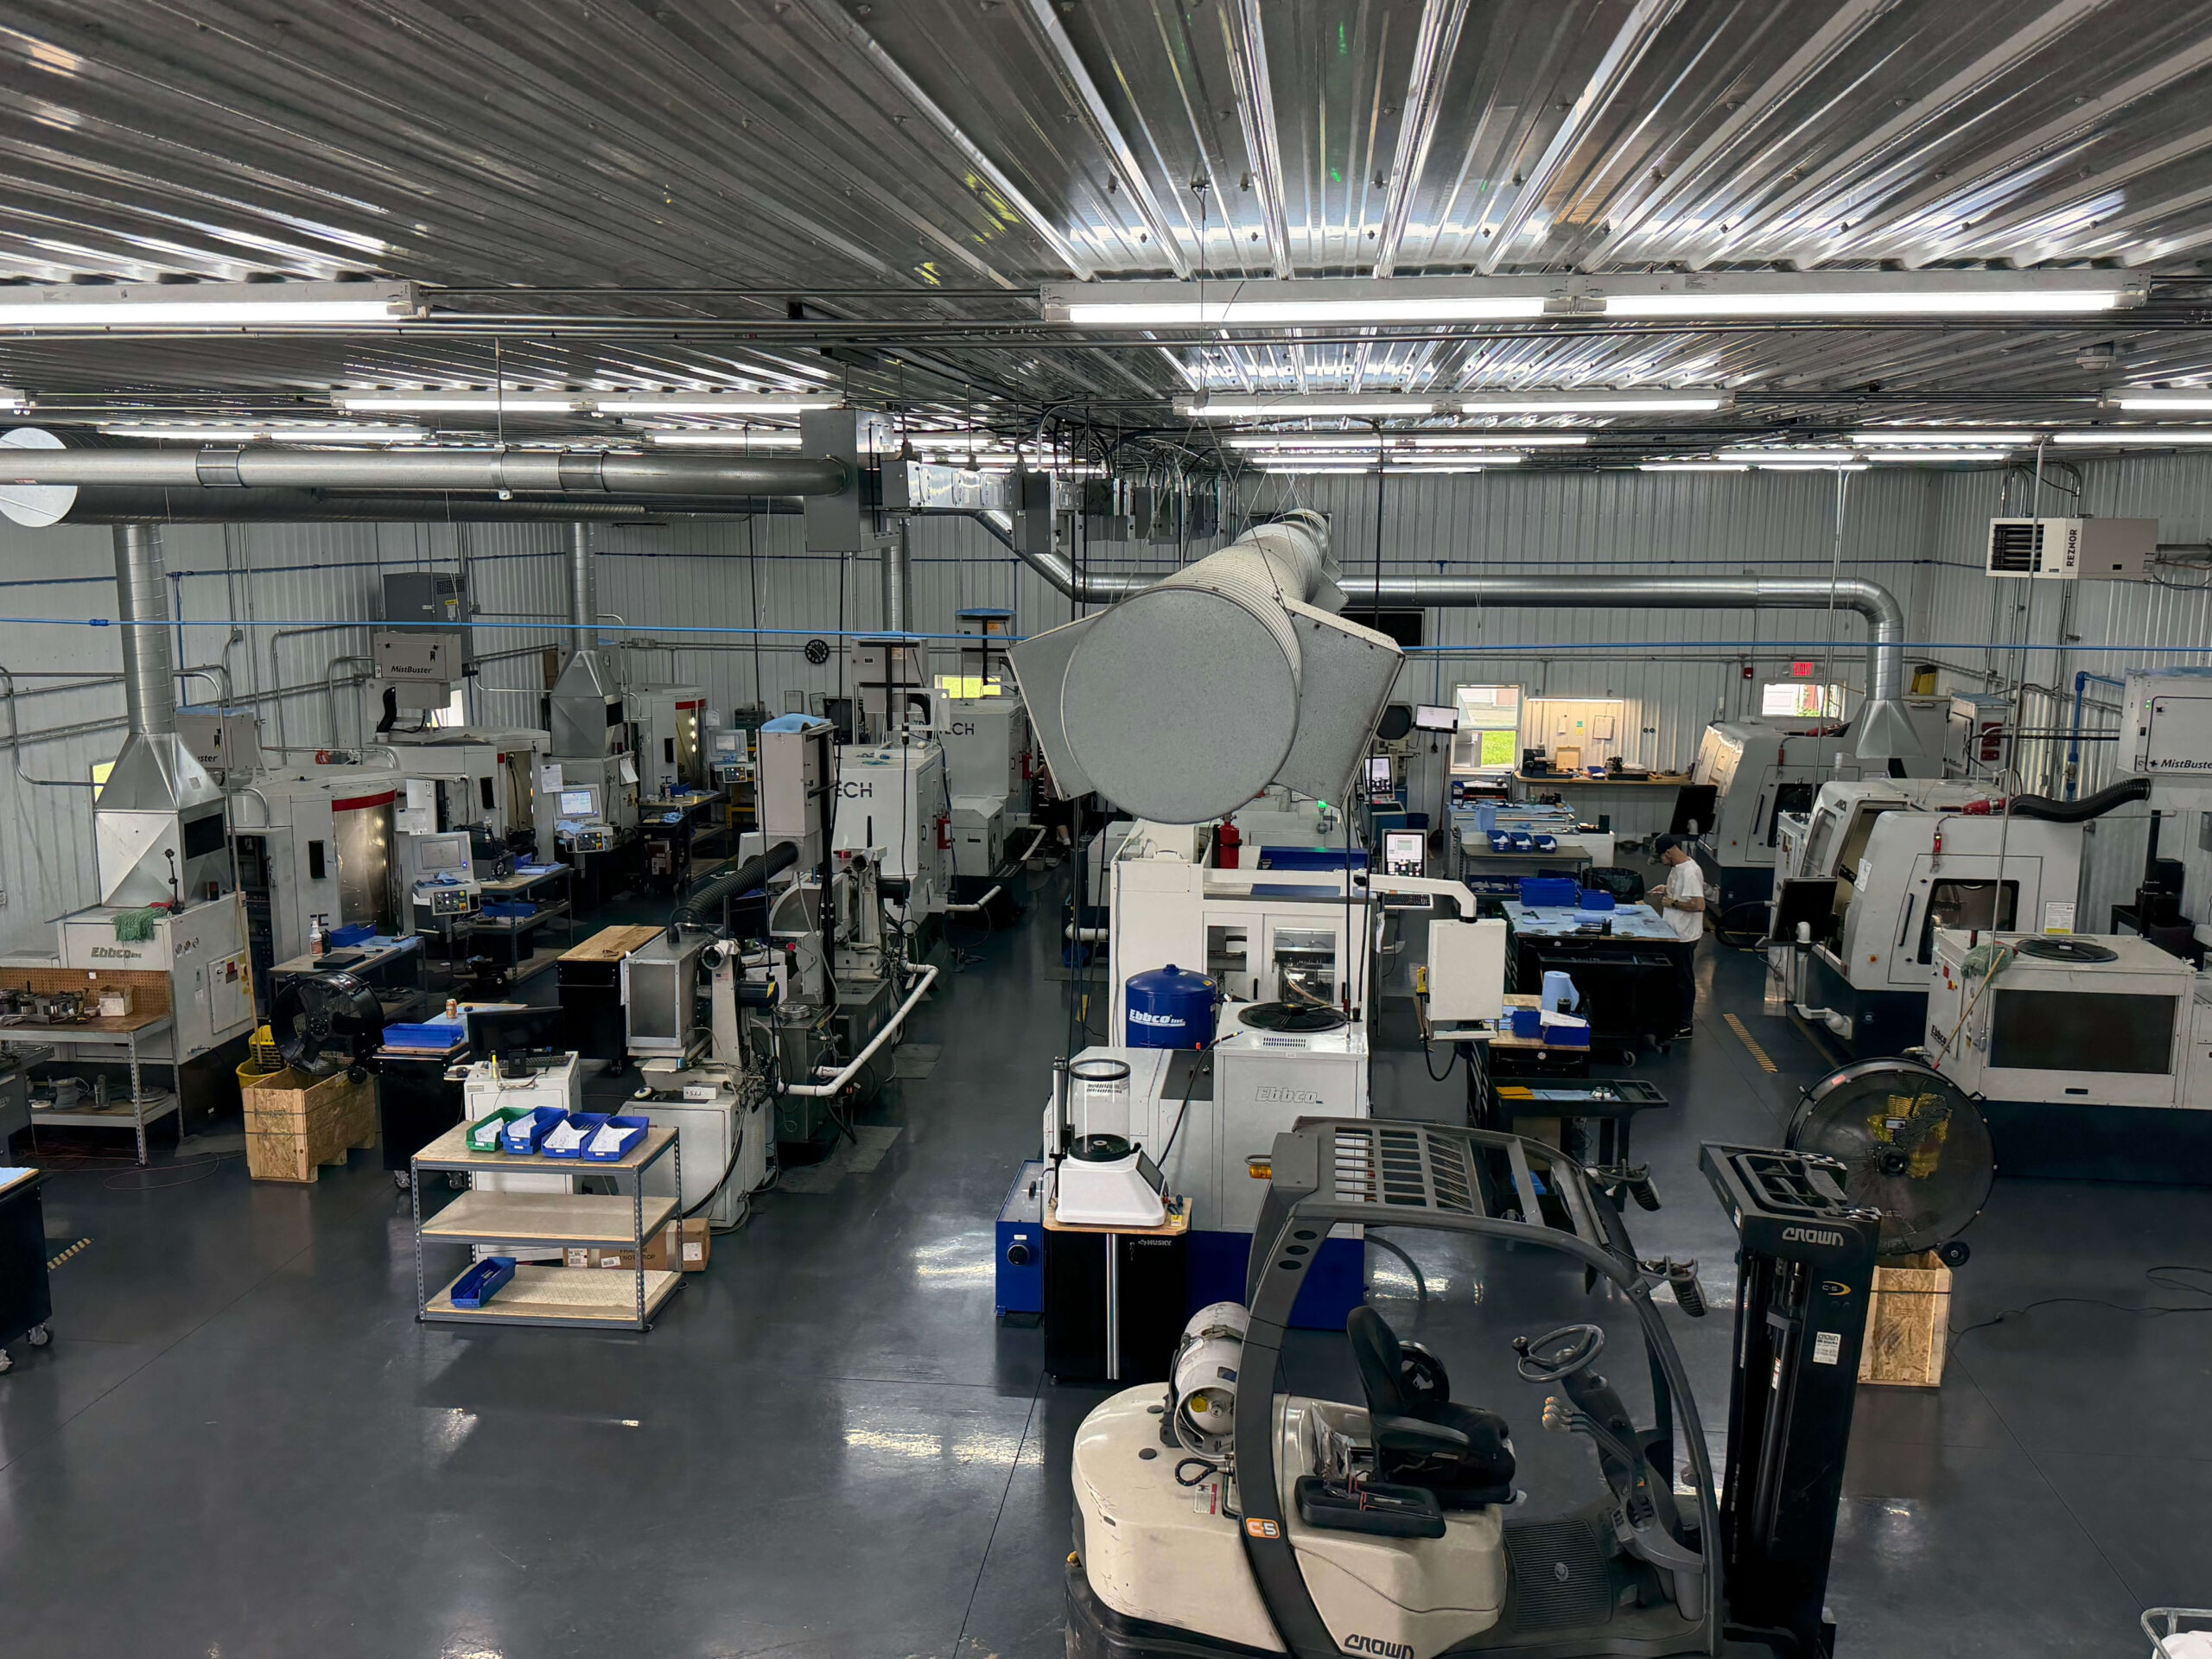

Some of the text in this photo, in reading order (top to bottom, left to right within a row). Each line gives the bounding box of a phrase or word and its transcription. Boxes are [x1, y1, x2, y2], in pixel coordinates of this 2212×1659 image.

[2066, 529, 2078, 567] REZNOR
[391, 665, 433, 674] MistBuster
[2160, 759, 2212, 769] MistBuste
[1129, 1008, 1172, 1024] Ebbco
[1255, 1086, 1318, 1103] Ebbco
[1782, 1227, 1844, 1246] CROWN
[1344, 1634, 1414, 1659] CROWN
